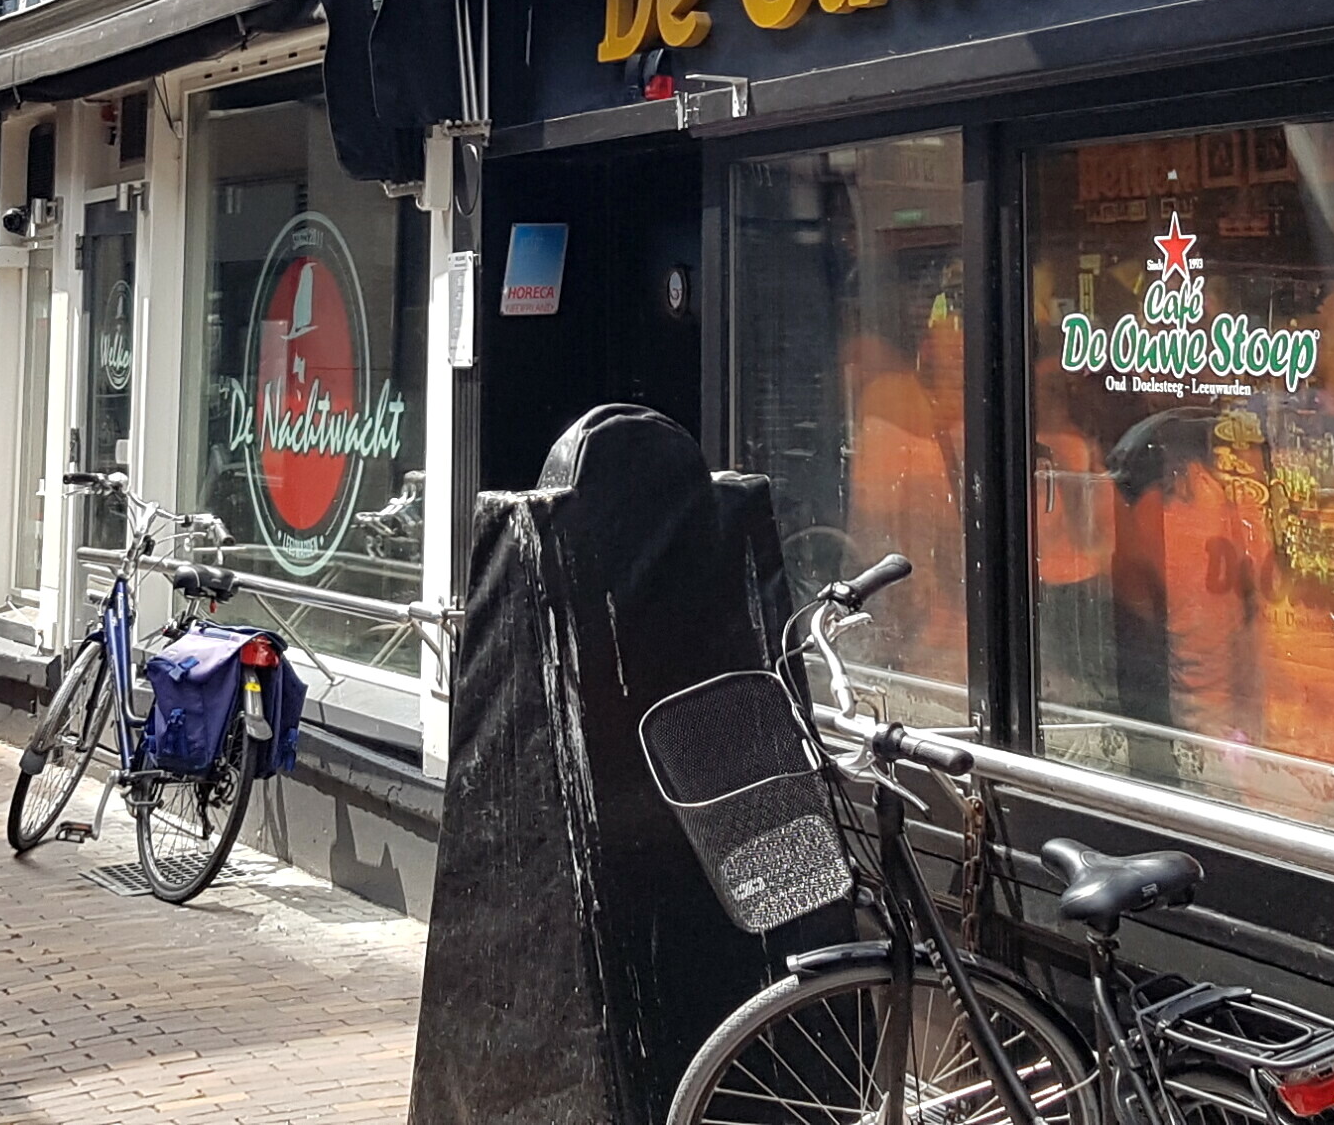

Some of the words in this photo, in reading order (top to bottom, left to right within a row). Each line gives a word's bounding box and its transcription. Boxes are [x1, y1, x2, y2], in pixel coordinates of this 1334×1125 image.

[507, 286, 556, 300] HORECA
[1143, 275, 1205, 330] Café
[100, 331, 133, 371] Welko
[1061, 313, 1107, 372] De
[1110, 313, 1208, 379] Ouwe
[1208, 312, 1317, 393] Stoep
[1105, 376, 1127, 392] Oud
[1191, 378, 1252, 396] Leeuwarden
[229, 377, 254, 452] De
[260, 377, 405, 460] Nachtwacht
